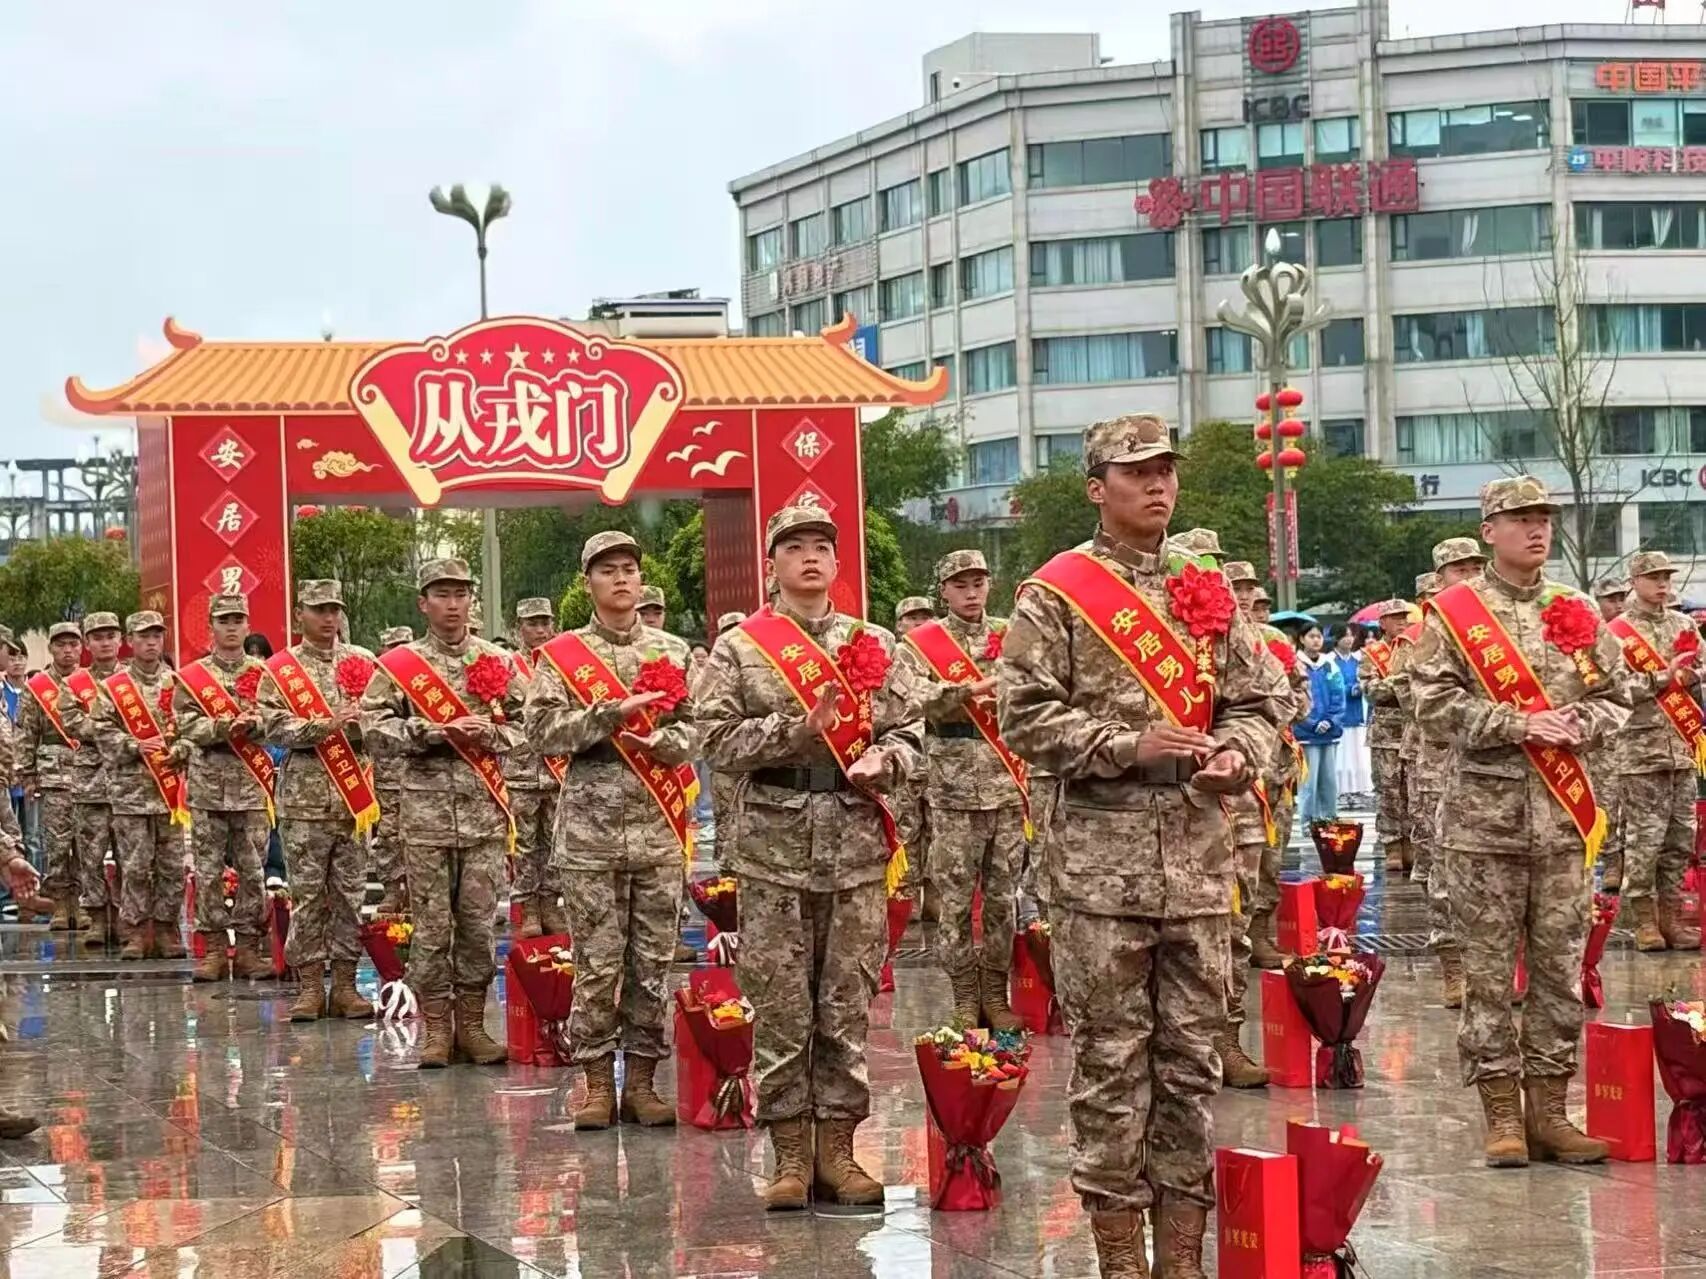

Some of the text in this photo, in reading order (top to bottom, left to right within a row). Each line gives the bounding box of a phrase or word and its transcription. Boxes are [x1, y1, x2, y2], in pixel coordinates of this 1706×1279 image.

[1201, 158, 1418, 226] 中国联通
[414, 378, 620, 458] 从戎门
[1641, 468, 1693, 487] ICBC
[1111, 607, 1205, 716] 安居男儿
[1466, 624, 1535, 711] 安居男儿
